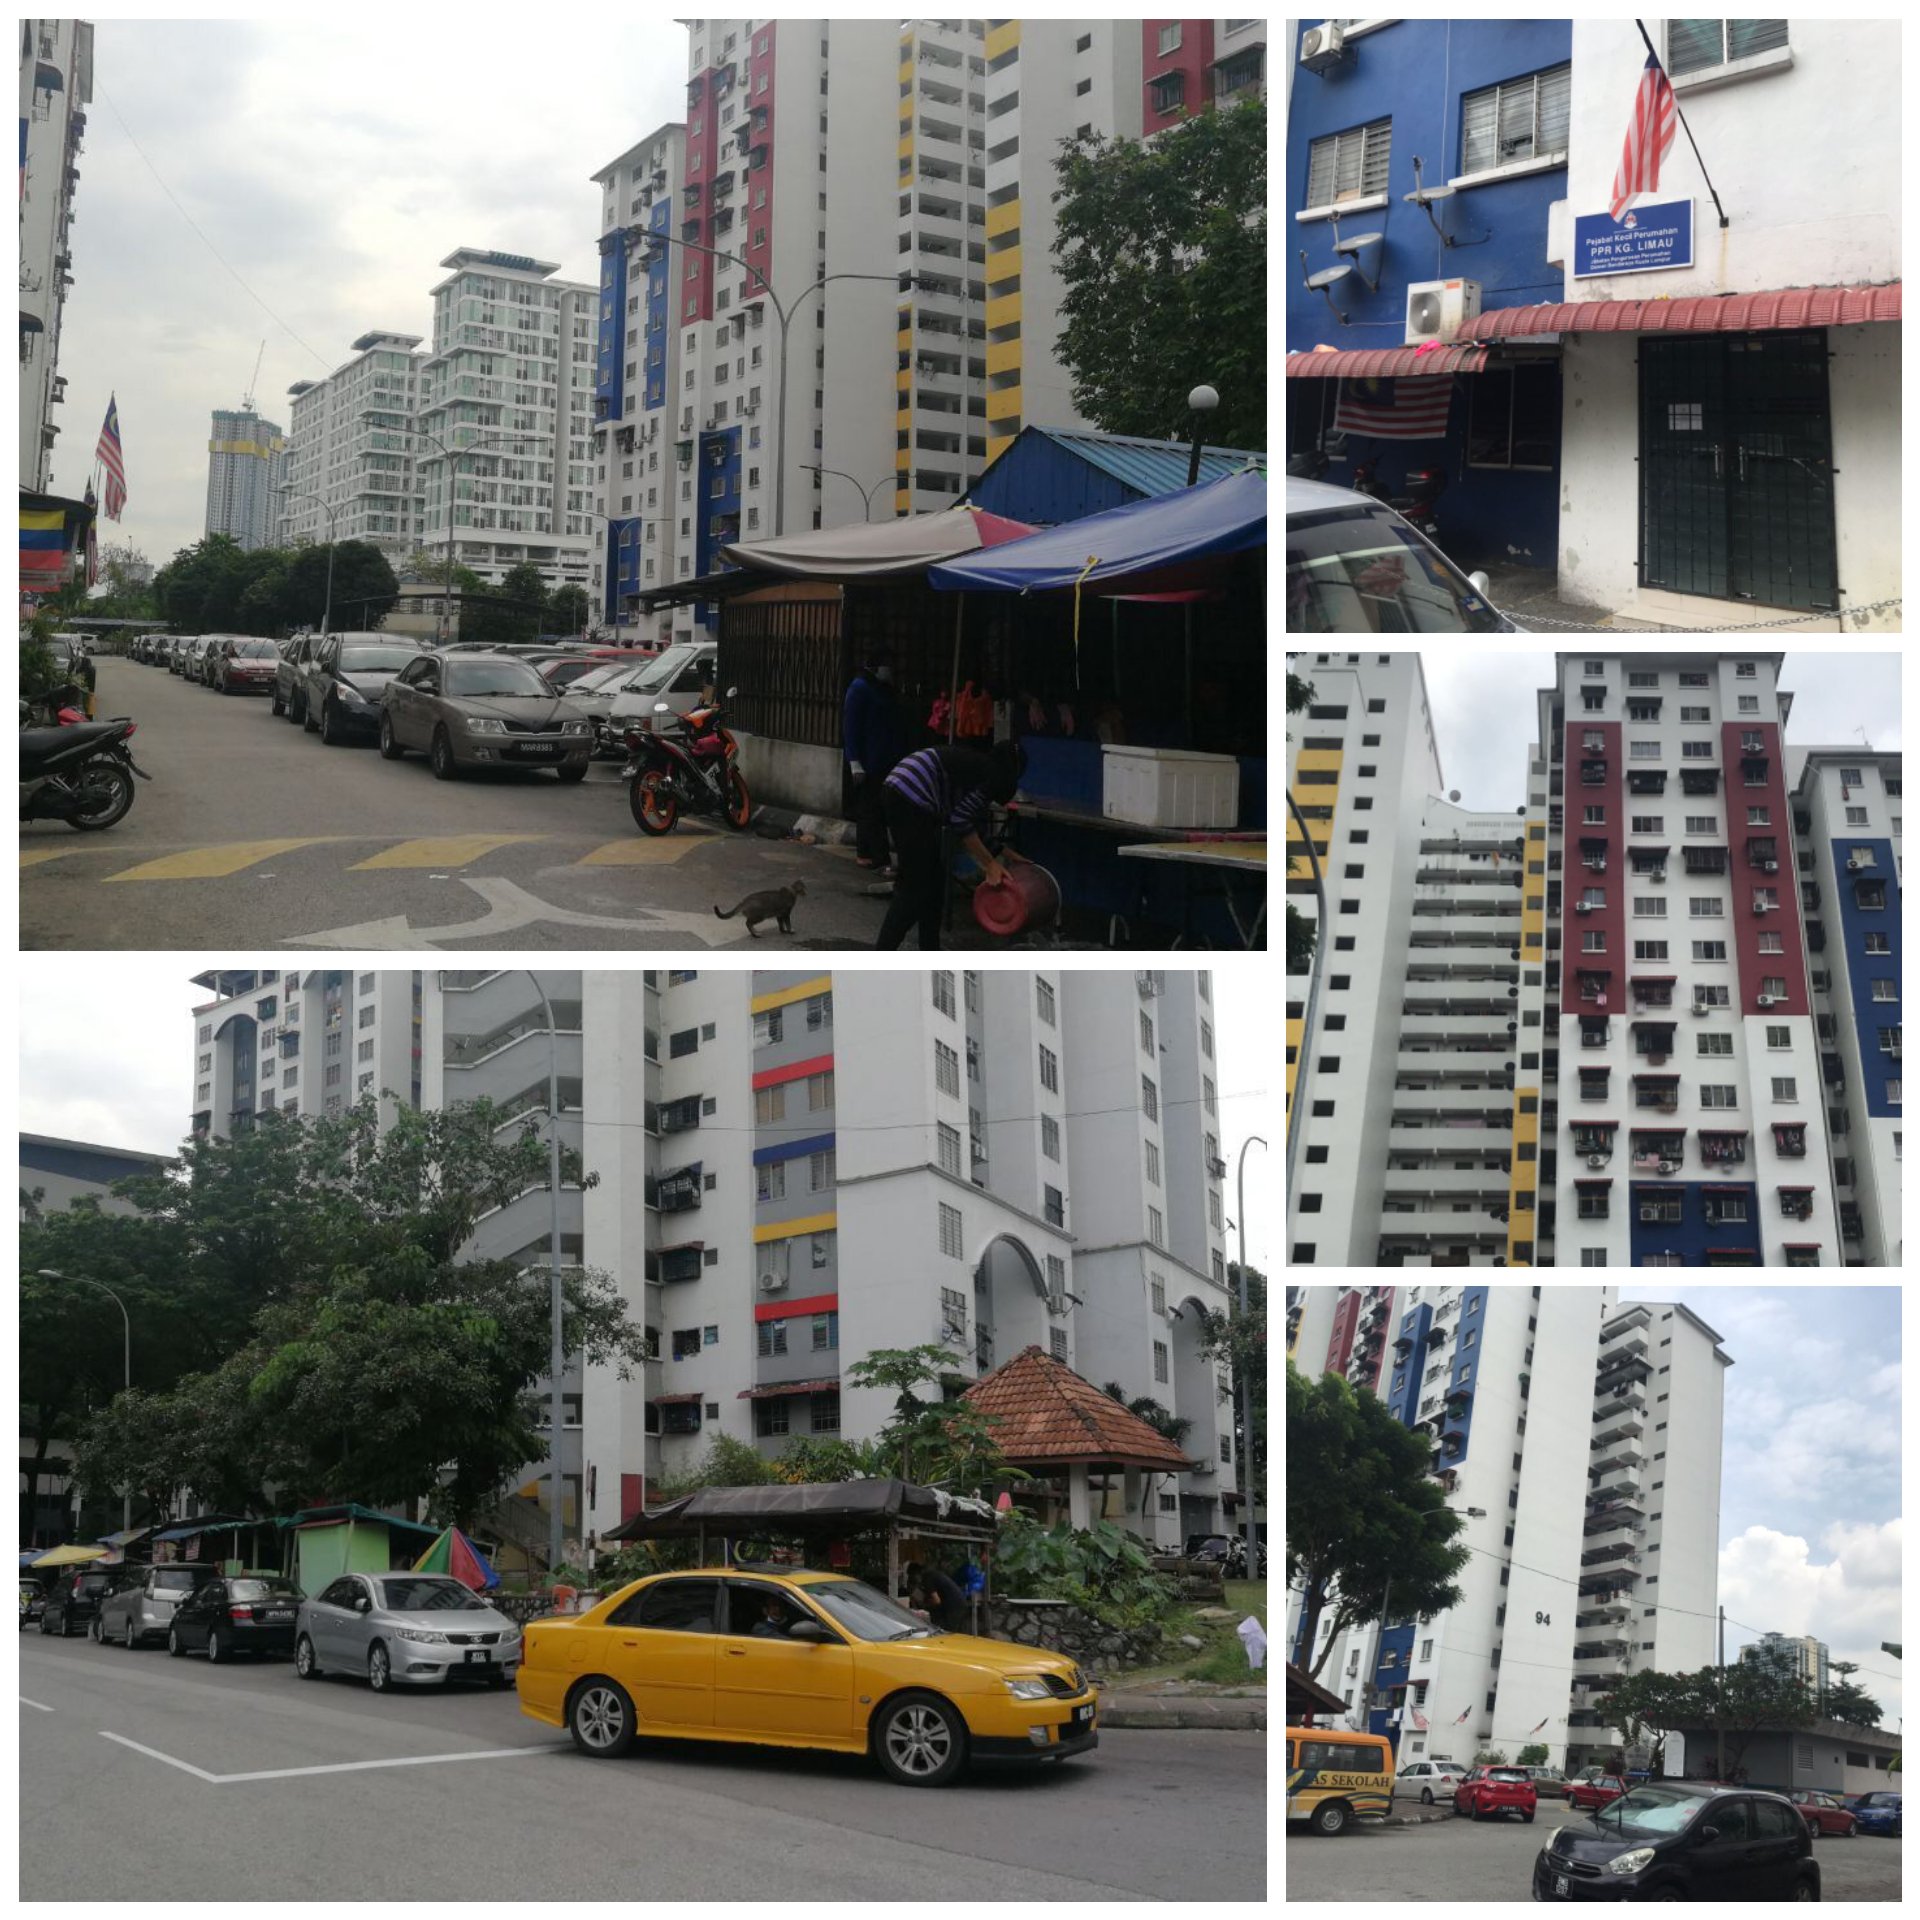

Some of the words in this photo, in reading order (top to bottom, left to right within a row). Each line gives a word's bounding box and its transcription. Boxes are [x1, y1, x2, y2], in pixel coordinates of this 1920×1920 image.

[1586, 236, 1613, 246] Pejabat
[1614, 233, 1633, 242] Kecil
[1634, 228, 1678, 239] Perumahan
[1591, 246, 1612, 257] PPR
[1615, 243, 1634, 254] KG.
[1638, 238, 1674, 251] LIMAU
[1535, 1610, 1551, 1626] 94
[1331, 1774, 1390, 1787] SEKOLAH
